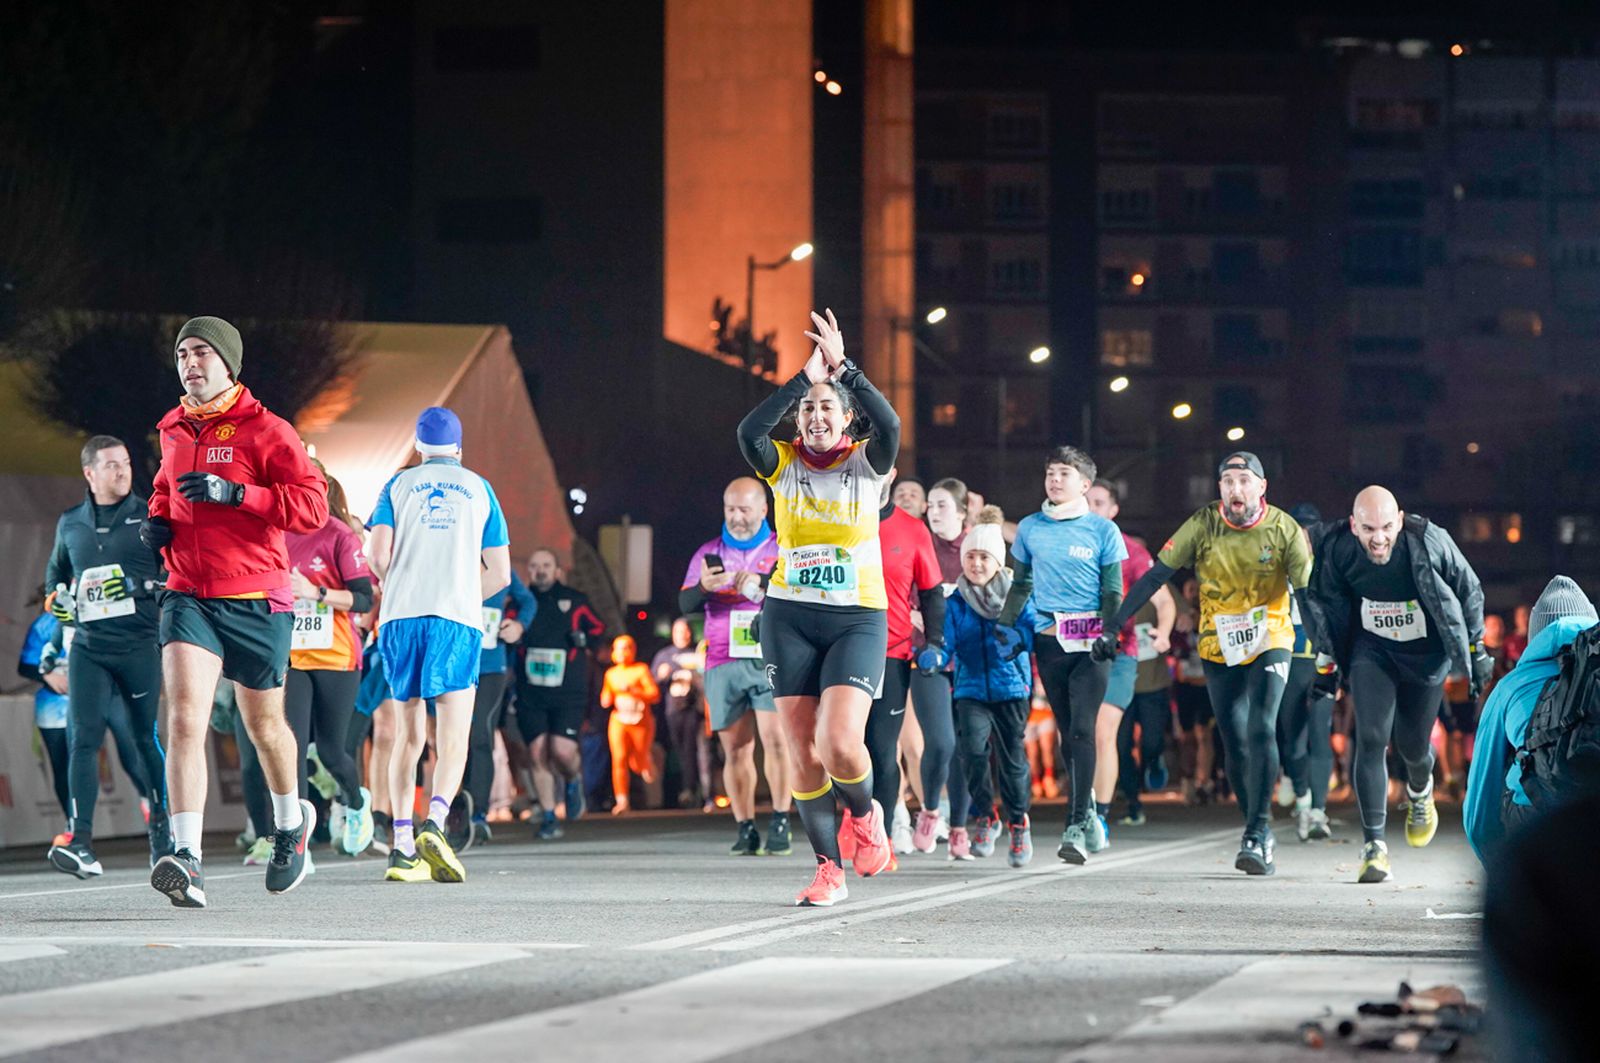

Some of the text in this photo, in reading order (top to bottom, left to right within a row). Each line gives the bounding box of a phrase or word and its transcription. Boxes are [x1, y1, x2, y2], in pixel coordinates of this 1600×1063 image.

[208, 449, 231, 461] AIG
[437, 482, 472, 500] RUNNING
[793, 561, 807, 569] SAN
[799, 565, 845, 585] 8240
[87, 586, 104, 602] 62
[296, 616, 322, 631] 288
[1374, 612, 1414, 629] 5068
[1227, 624, 1259, 648] 5067
